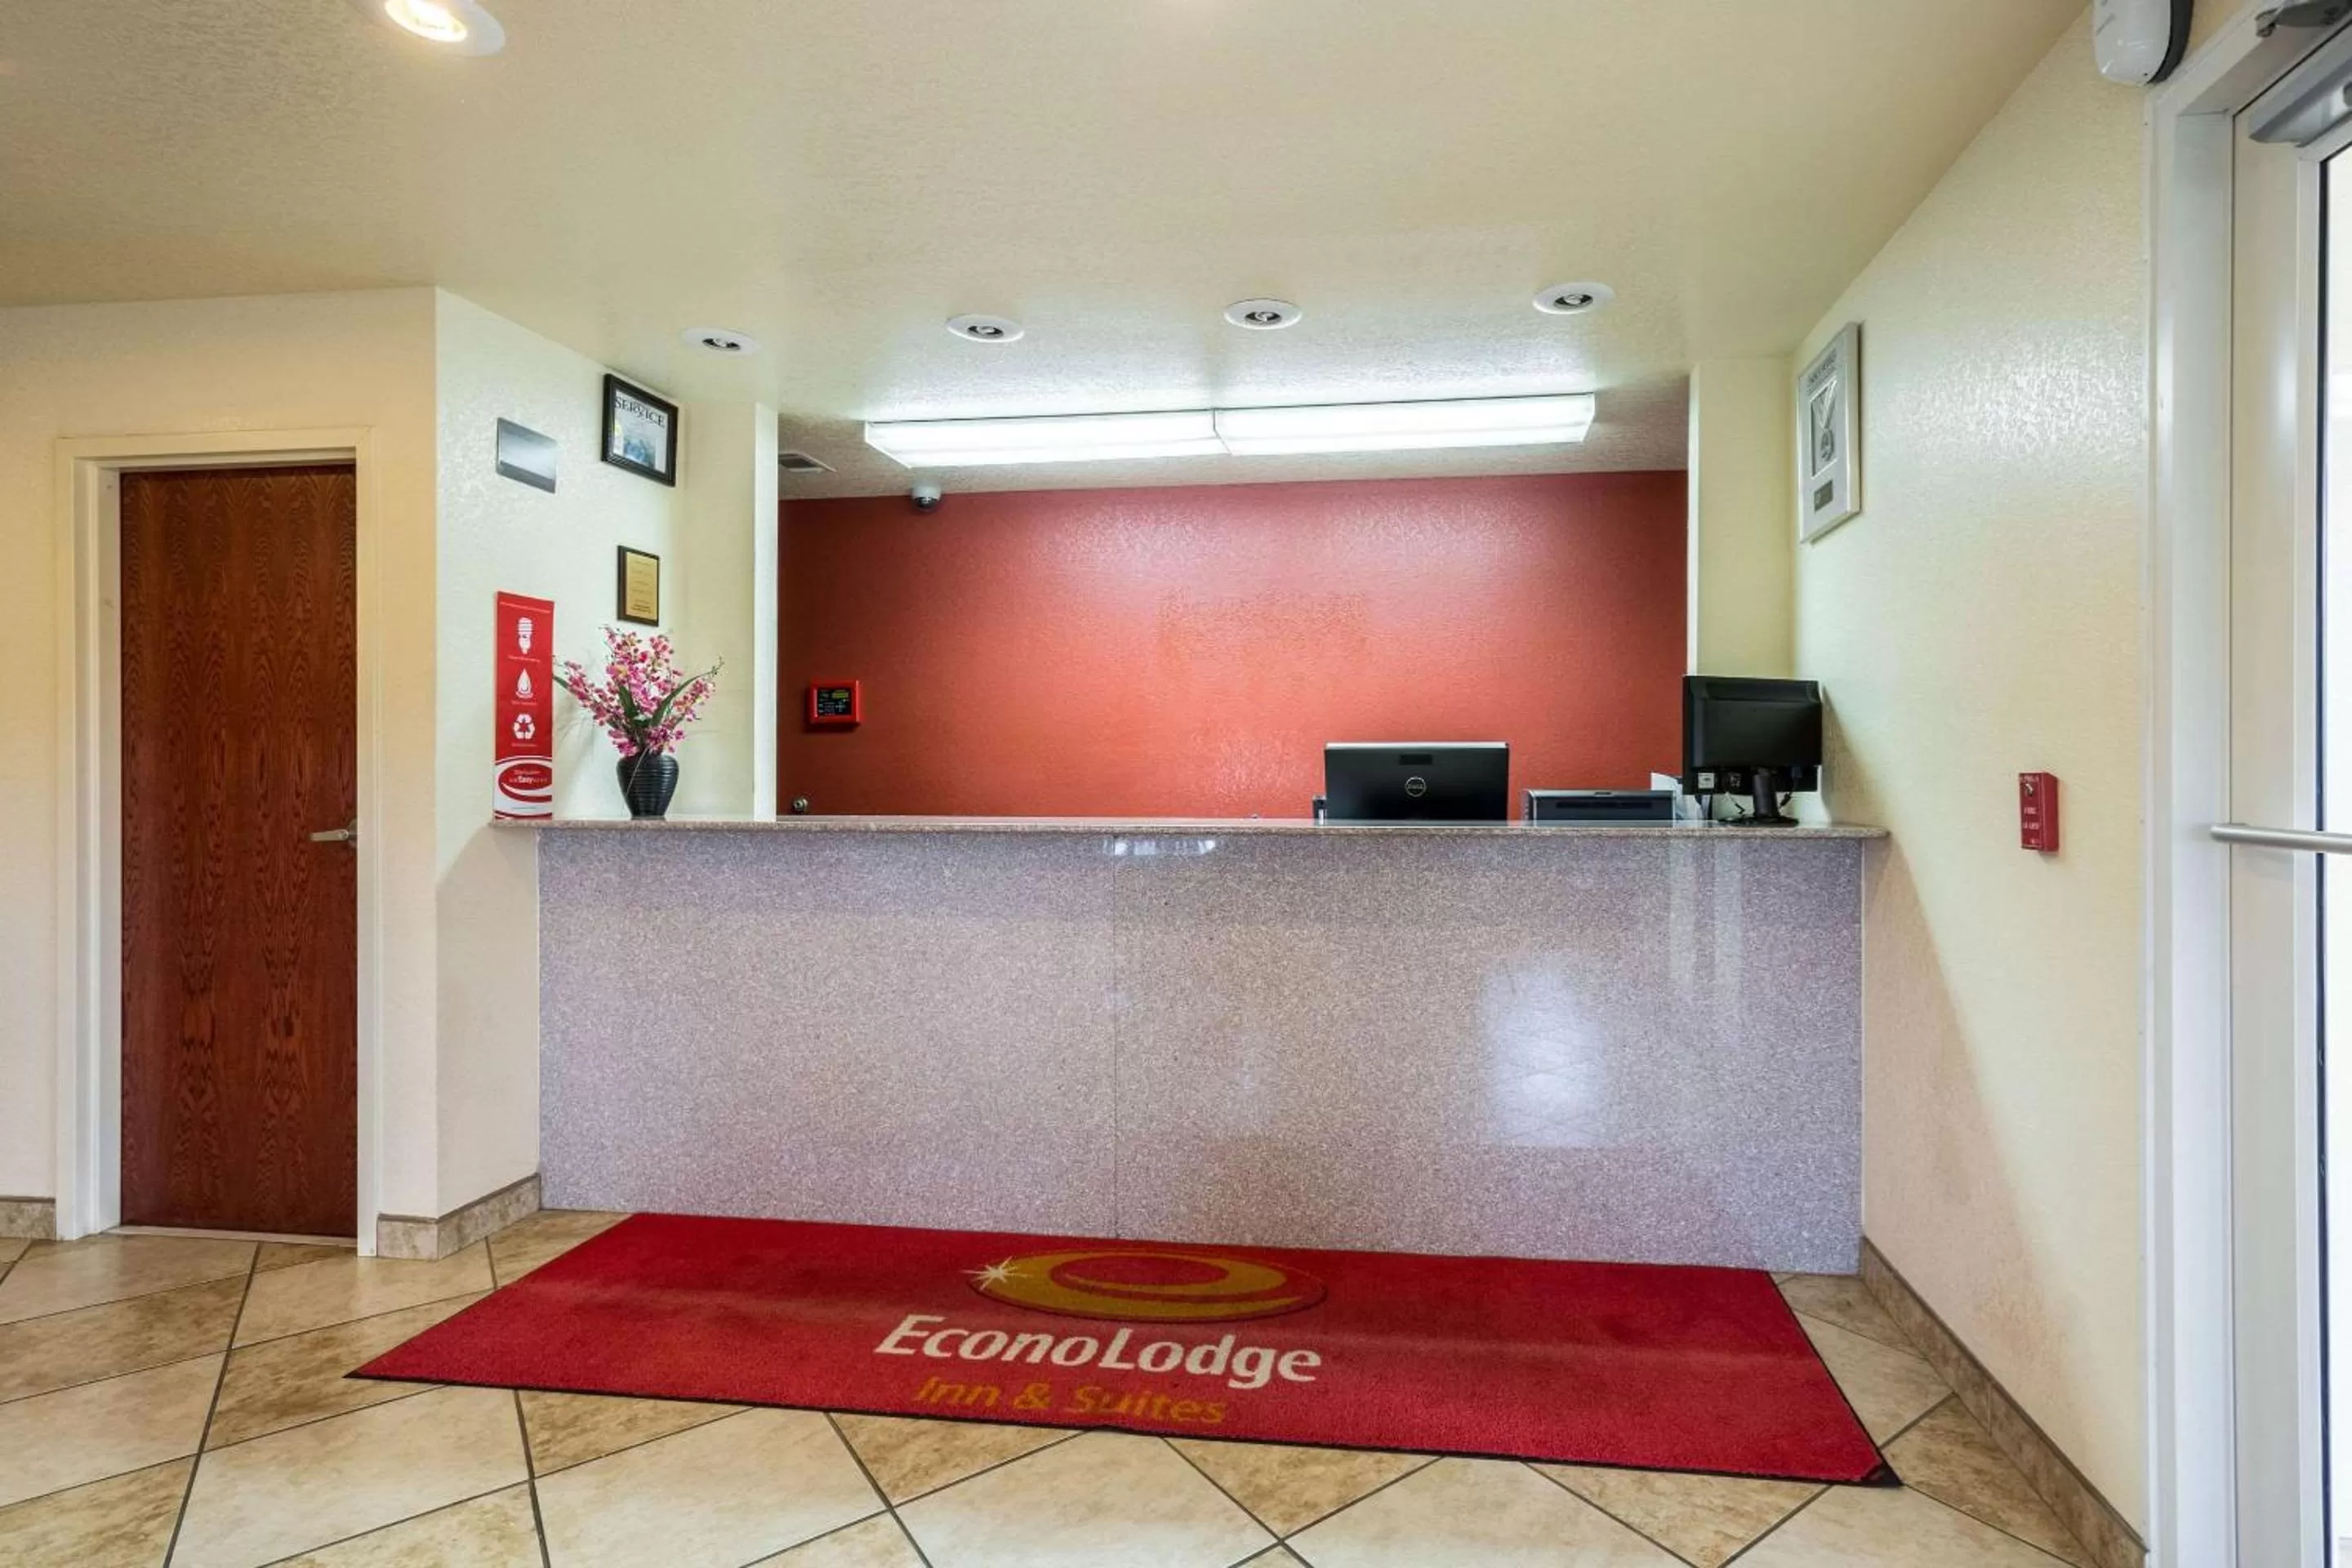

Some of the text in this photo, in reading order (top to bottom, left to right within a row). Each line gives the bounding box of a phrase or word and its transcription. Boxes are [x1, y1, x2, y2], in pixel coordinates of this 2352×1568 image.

[615, 397, 666, 428] SERVICE
[874, 1315, 1322, 1389] EconoLodge
[914, 1377, 1226, 1424] Inn & Suites
